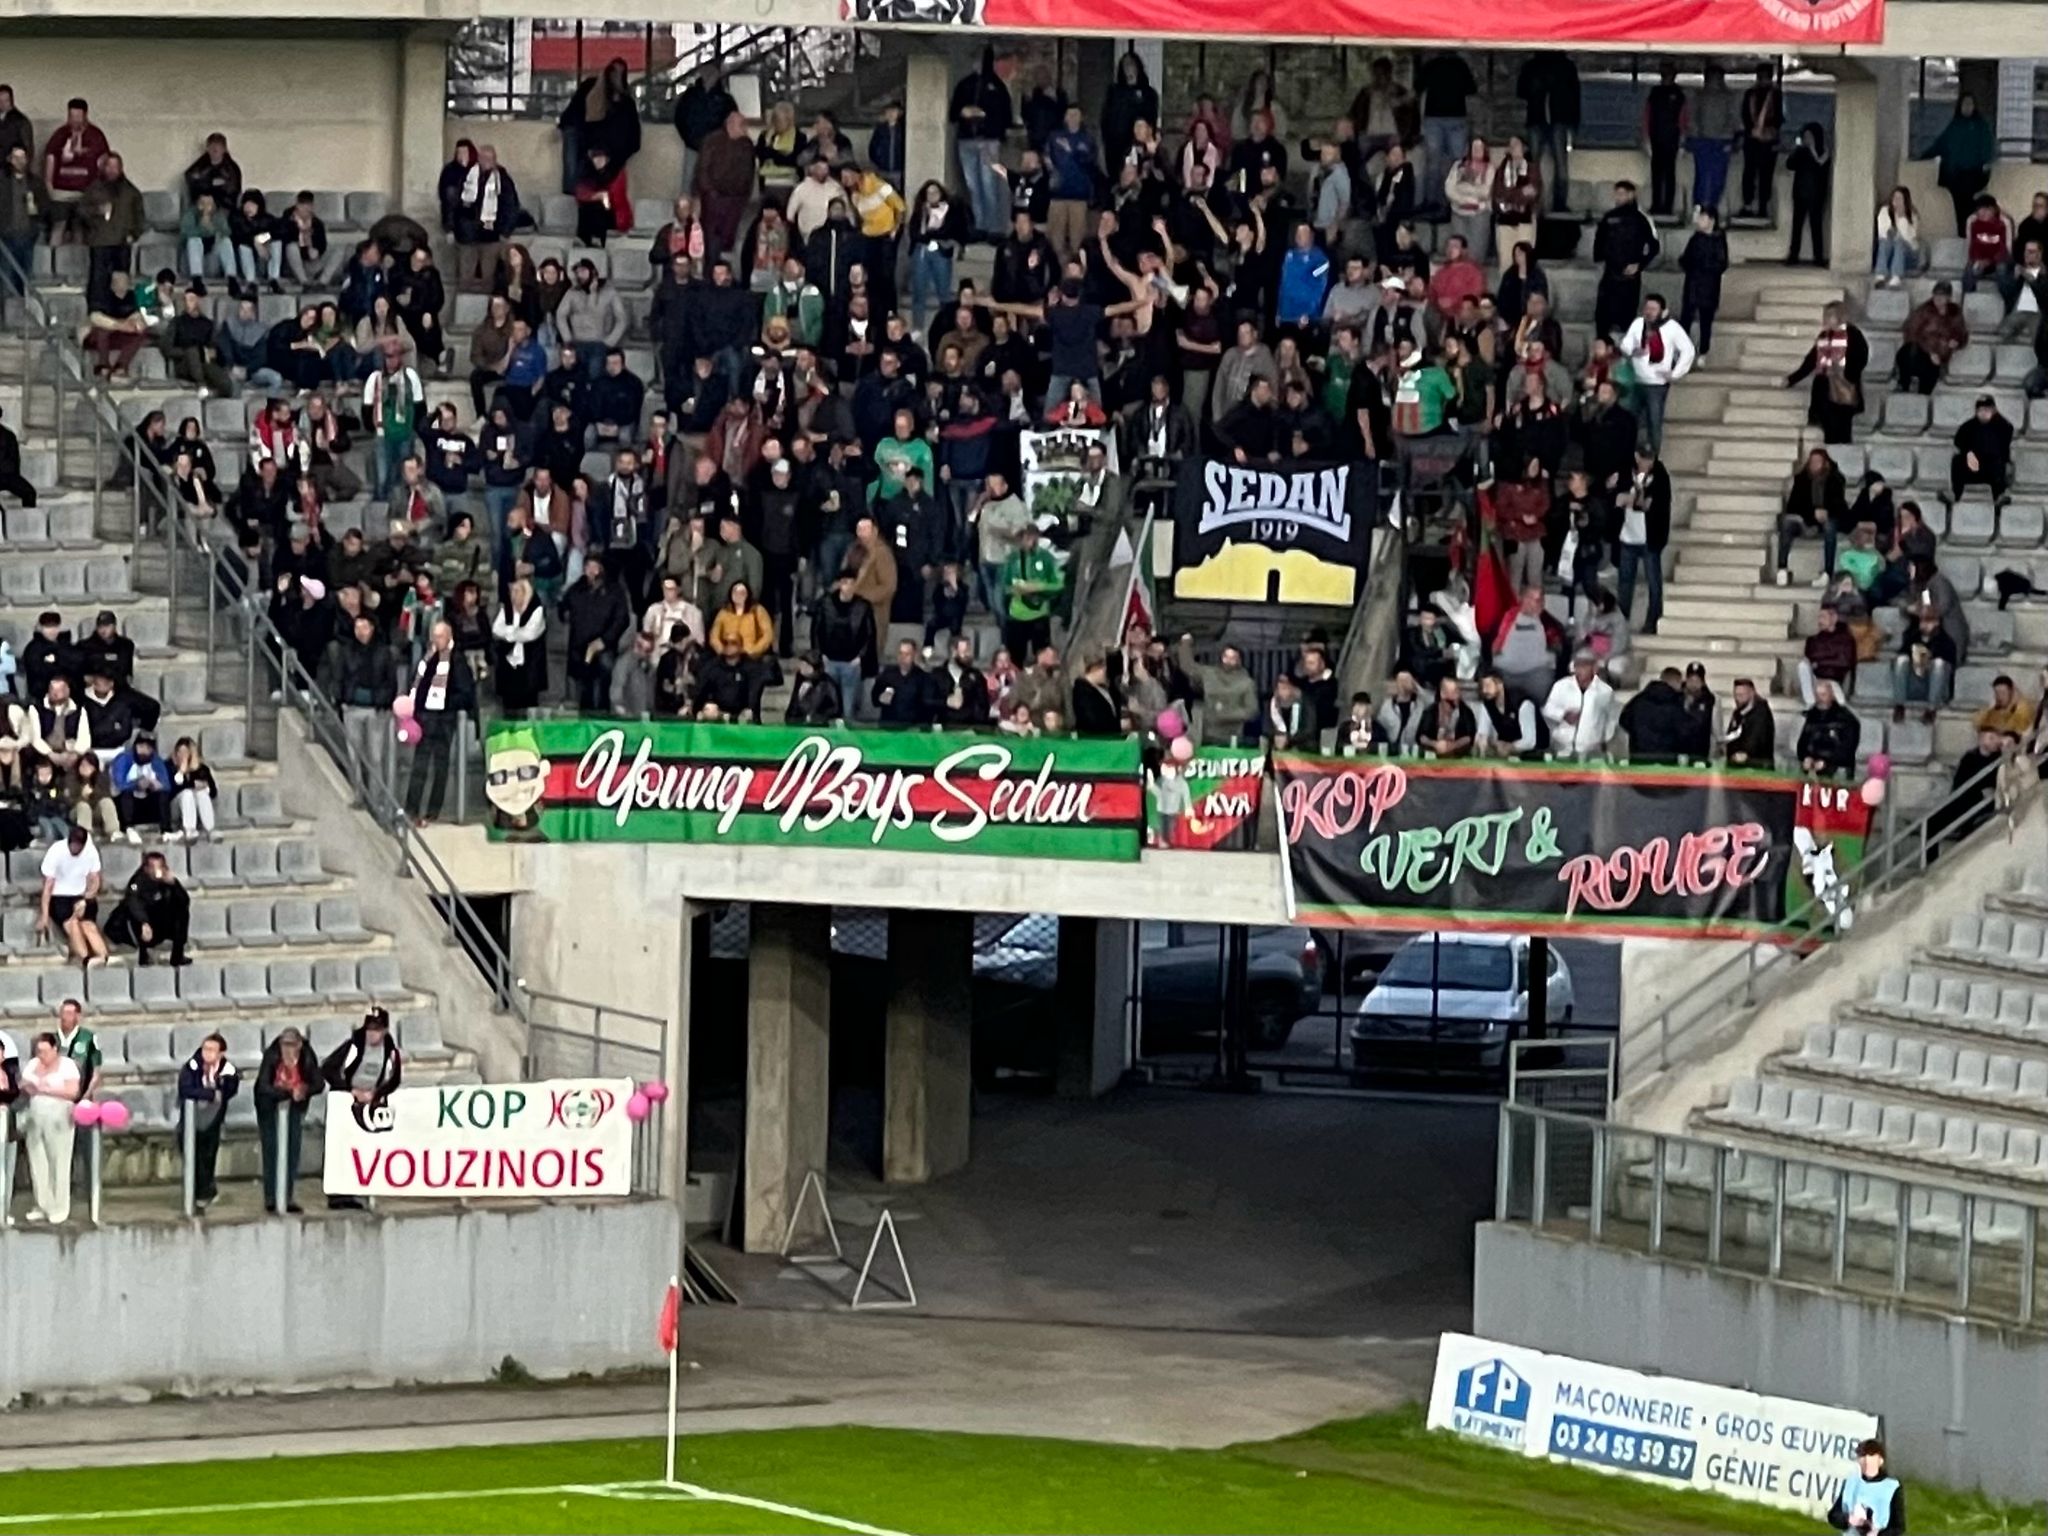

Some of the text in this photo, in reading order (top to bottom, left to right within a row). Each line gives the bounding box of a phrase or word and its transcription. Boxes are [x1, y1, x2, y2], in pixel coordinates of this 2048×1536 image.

[1203, 460, 1349, 523] SEDAN
[1251, 520, 1299, 541] 1919
[576, 729, 1095, 843] Young Boys Sedan
[1283, 764, 1407, 844] KOP
[1360, 806, 1563, 894] VERT &
[1558, 822, 1769, 921] ROUGE
[437, 1088, 527, 1129] KOP
[351, 1148, 604, 1188] VOUZINOIS
[1468, 1361, 1519, 1414] FP
[1556, 1381, 1694, 1430] MAÇONNERIE
[1716, 1411, 1773, 1446] GROS
[1555, 1422, 1694, 1472] 03 24 55 59 57
